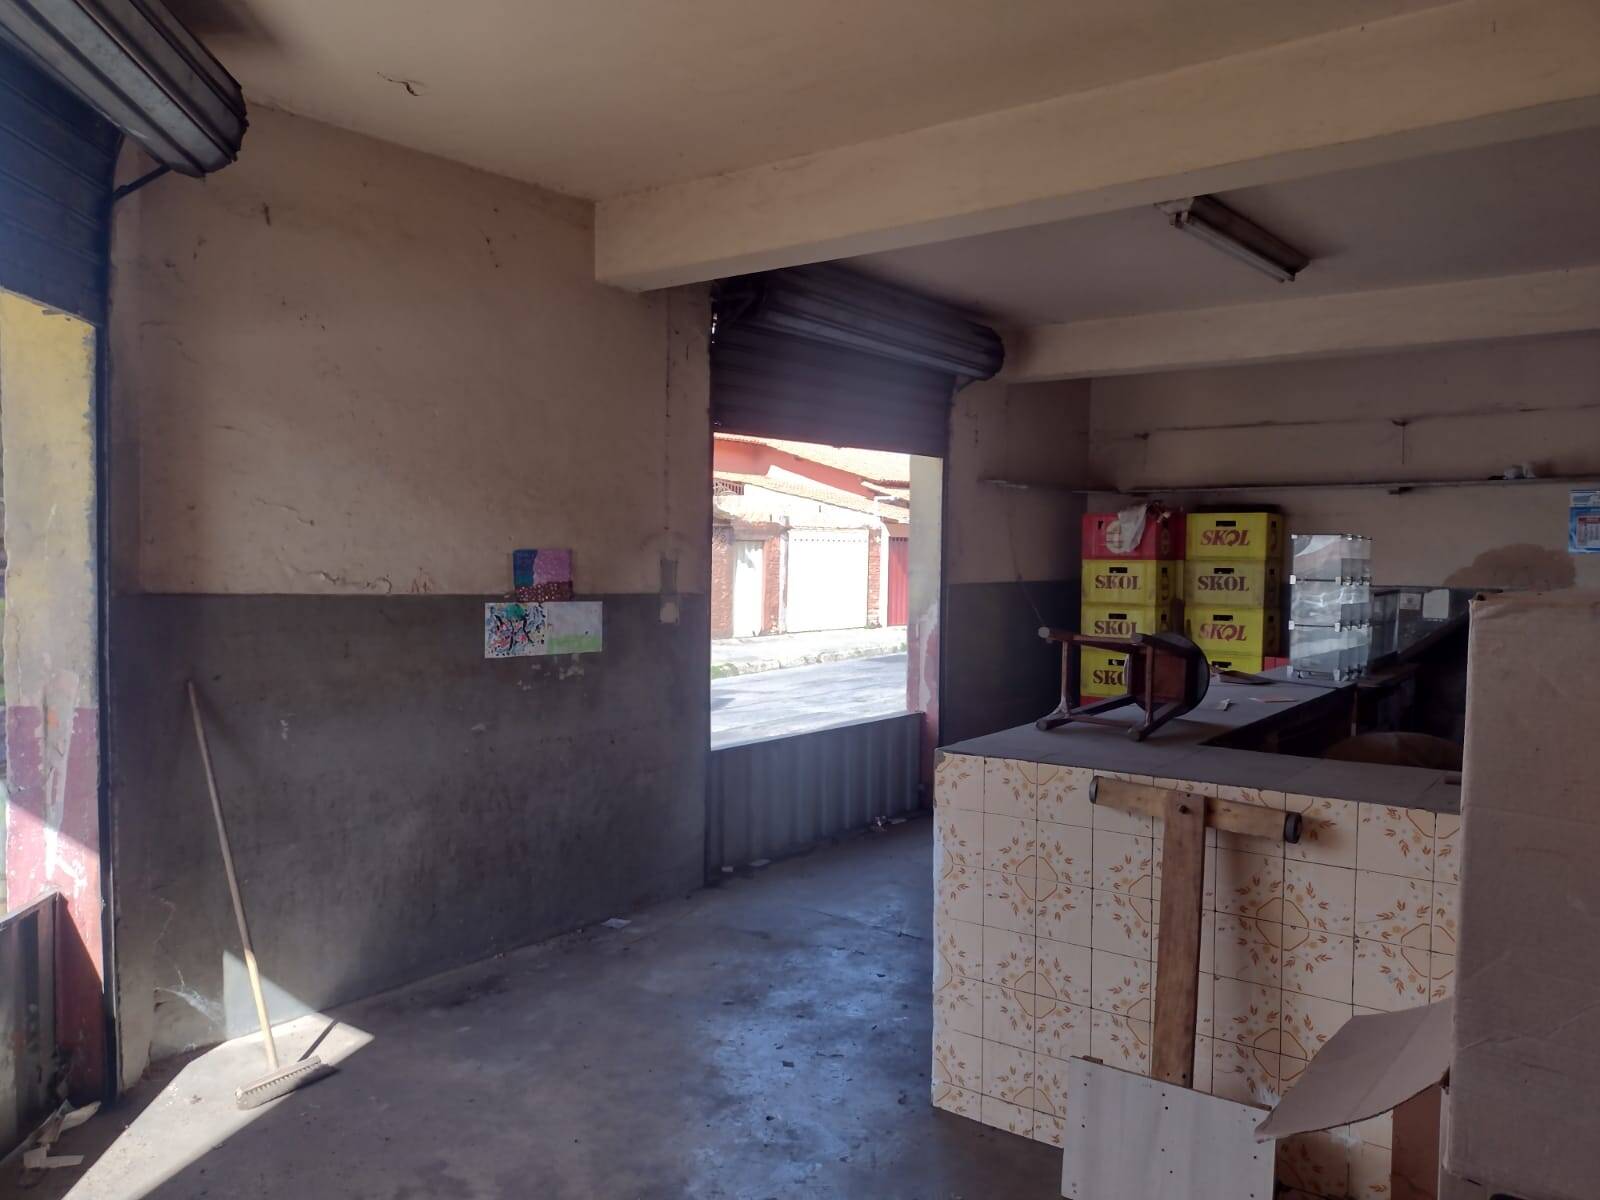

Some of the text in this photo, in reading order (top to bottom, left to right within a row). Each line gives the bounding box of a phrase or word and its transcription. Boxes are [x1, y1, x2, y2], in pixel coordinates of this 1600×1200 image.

[1200, 529, 1250, 547] SKOL
[1095, 574, 1141, 590] SKOL
[1197, 575, 1250, 592] SKOL
[1198, 623, 1247, 642] SKOL
[1092, 669, 1125, 685] SKO
